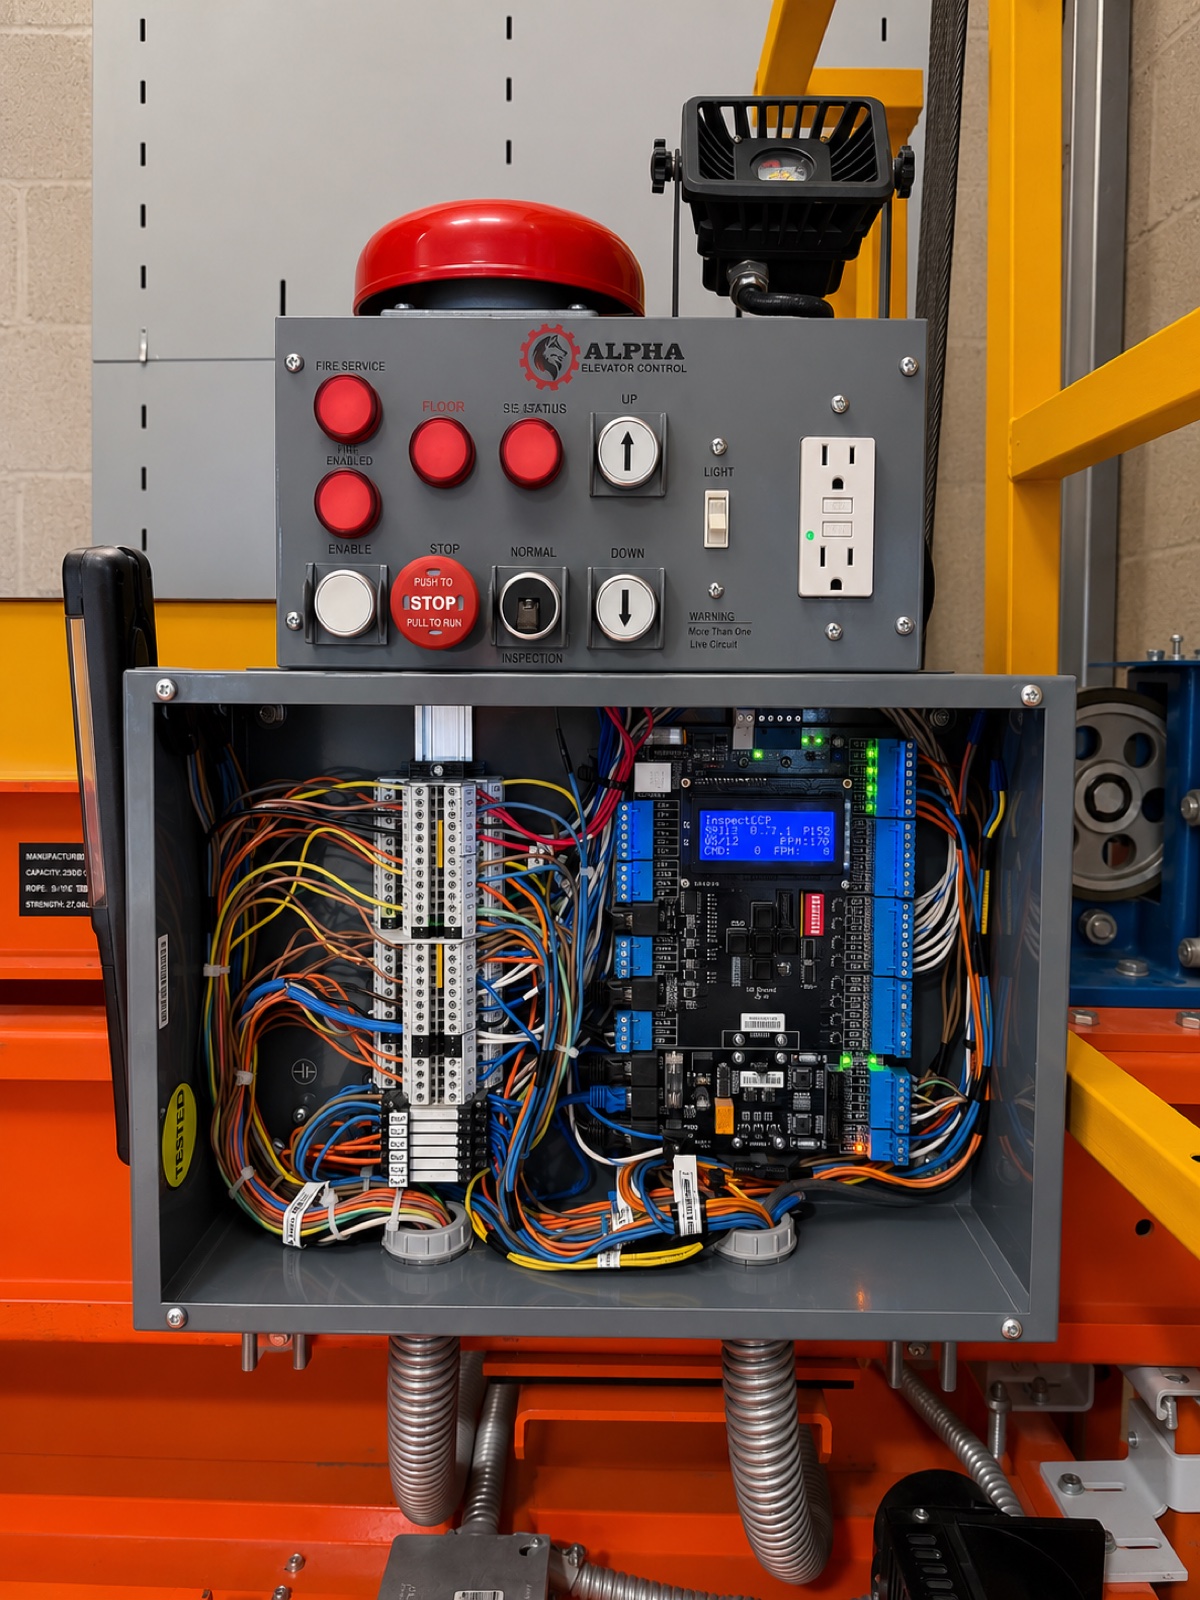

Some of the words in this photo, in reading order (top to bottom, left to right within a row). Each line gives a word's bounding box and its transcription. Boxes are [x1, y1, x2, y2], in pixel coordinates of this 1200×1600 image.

[583, 342, 685, 360] ALPHA
[316, 361, 340, 371] FIRE
[342, 361, 386, 371] SERVICE
[581, 363, 634, 373] ELEVATOR
[637, 364, 687, 373] CONTROL
[621, 394, 638, 404] UP
[422, 401, 465, 412] FLOOR
[326, 455, 373, 466] ENABLED
[704, 467, 734, 477] LIGHT
[328, 544, 372, 555] ENABLE
[430, 543, 460, 555] STOP
[511, 546, 557, 558] NORMAL
[611, 547, 645, 559] DOWN
[414, 577, 438, 587] PUSH
[439, 577, 453, 587] TO
[410, 595, 456, 611] STOP
[689, 611, 735, 621] WARNING
[407, 618, 428, 627] PULL
[429, 618, 442, 627] TO
[443, 618, 462, 628] RUN
[688, 627, 709, 635] More
[712, 627, 733, 635] Than
[735, 627, 752, 636] One
[690, 640, 707, 649] Live
[709, 640, 738, 649] Circuit
[502, 653, 563, 664] INSPECTION
[175, 1088, 185, 1181] TESTED
